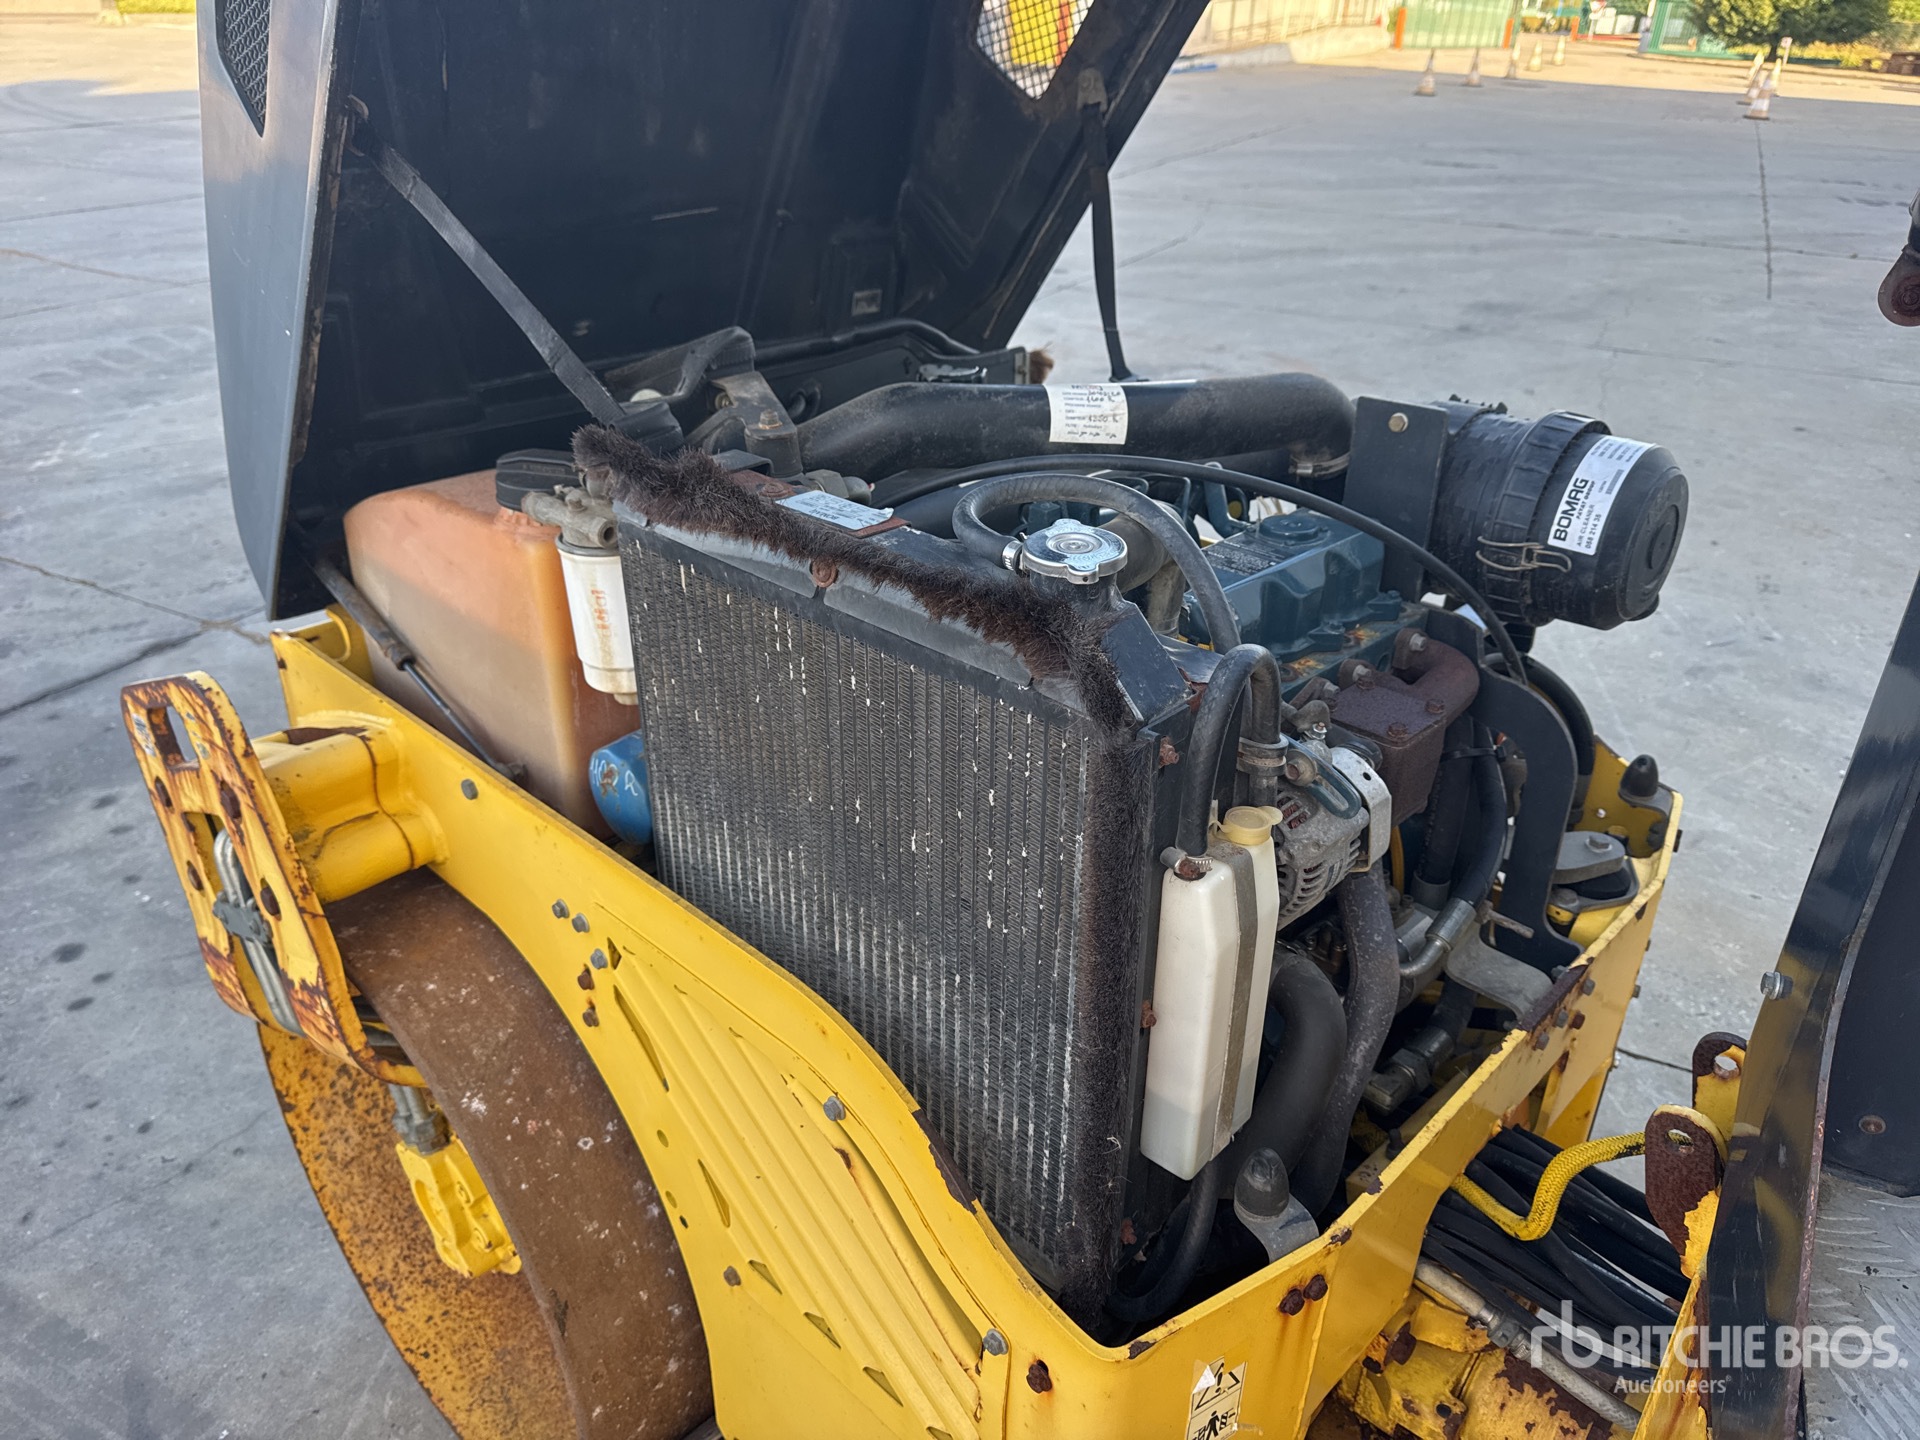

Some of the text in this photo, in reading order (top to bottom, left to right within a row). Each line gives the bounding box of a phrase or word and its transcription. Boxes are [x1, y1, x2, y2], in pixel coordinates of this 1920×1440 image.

[1584, 480, 1596, 500] GROUP
[1553, 477, 1589, 541] BOMAG
[1576, 504, 1595, 547] AIR CLEANER
[1589, 523, 1598, 536] 214
